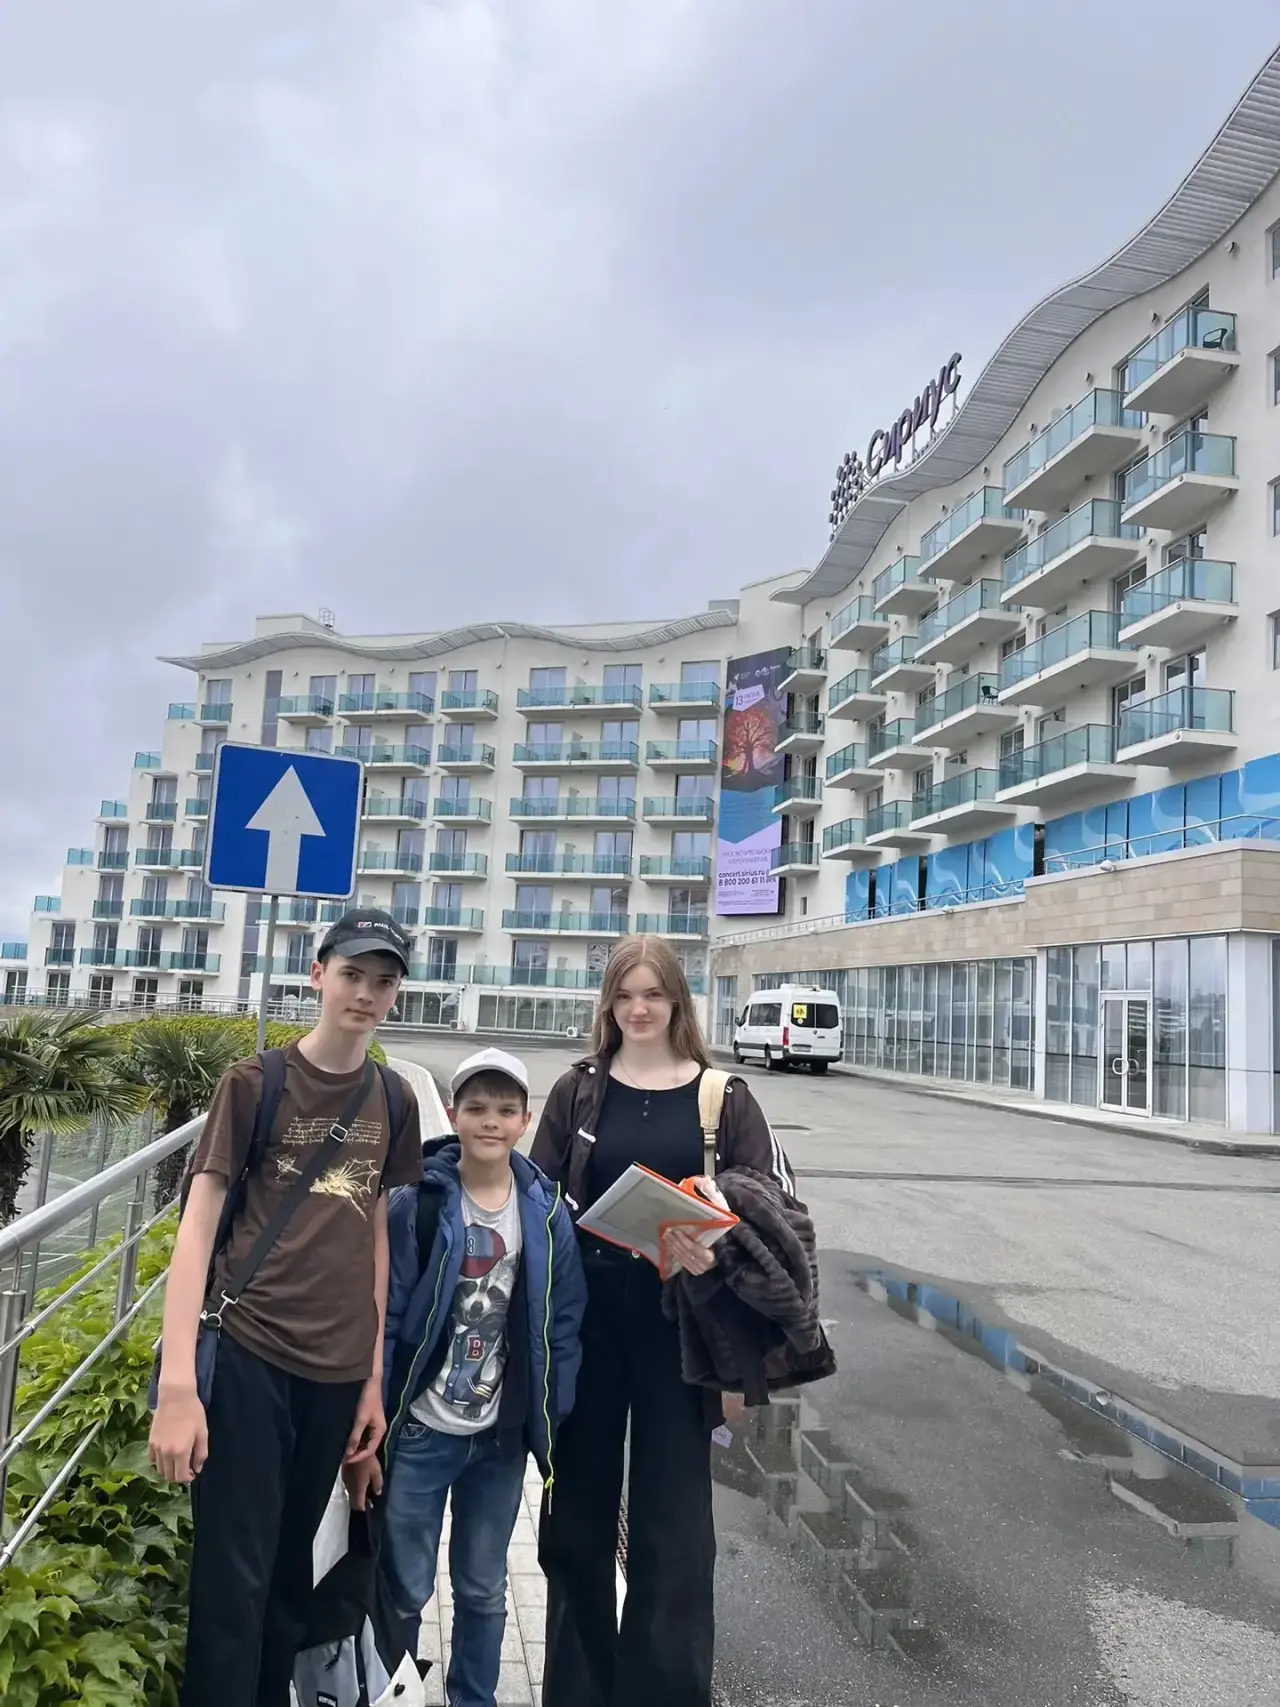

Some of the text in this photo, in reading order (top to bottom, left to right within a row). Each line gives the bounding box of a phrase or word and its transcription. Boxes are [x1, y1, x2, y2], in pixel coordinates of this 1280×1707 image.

[867, 352, 962, 477] Сириус
[735, 695, 743, 706] 13
[718, 870, 765, 878] concert.sirius.ru
[738, 877, 750, 885] 200
[465, 1335, 485, 1361] B
